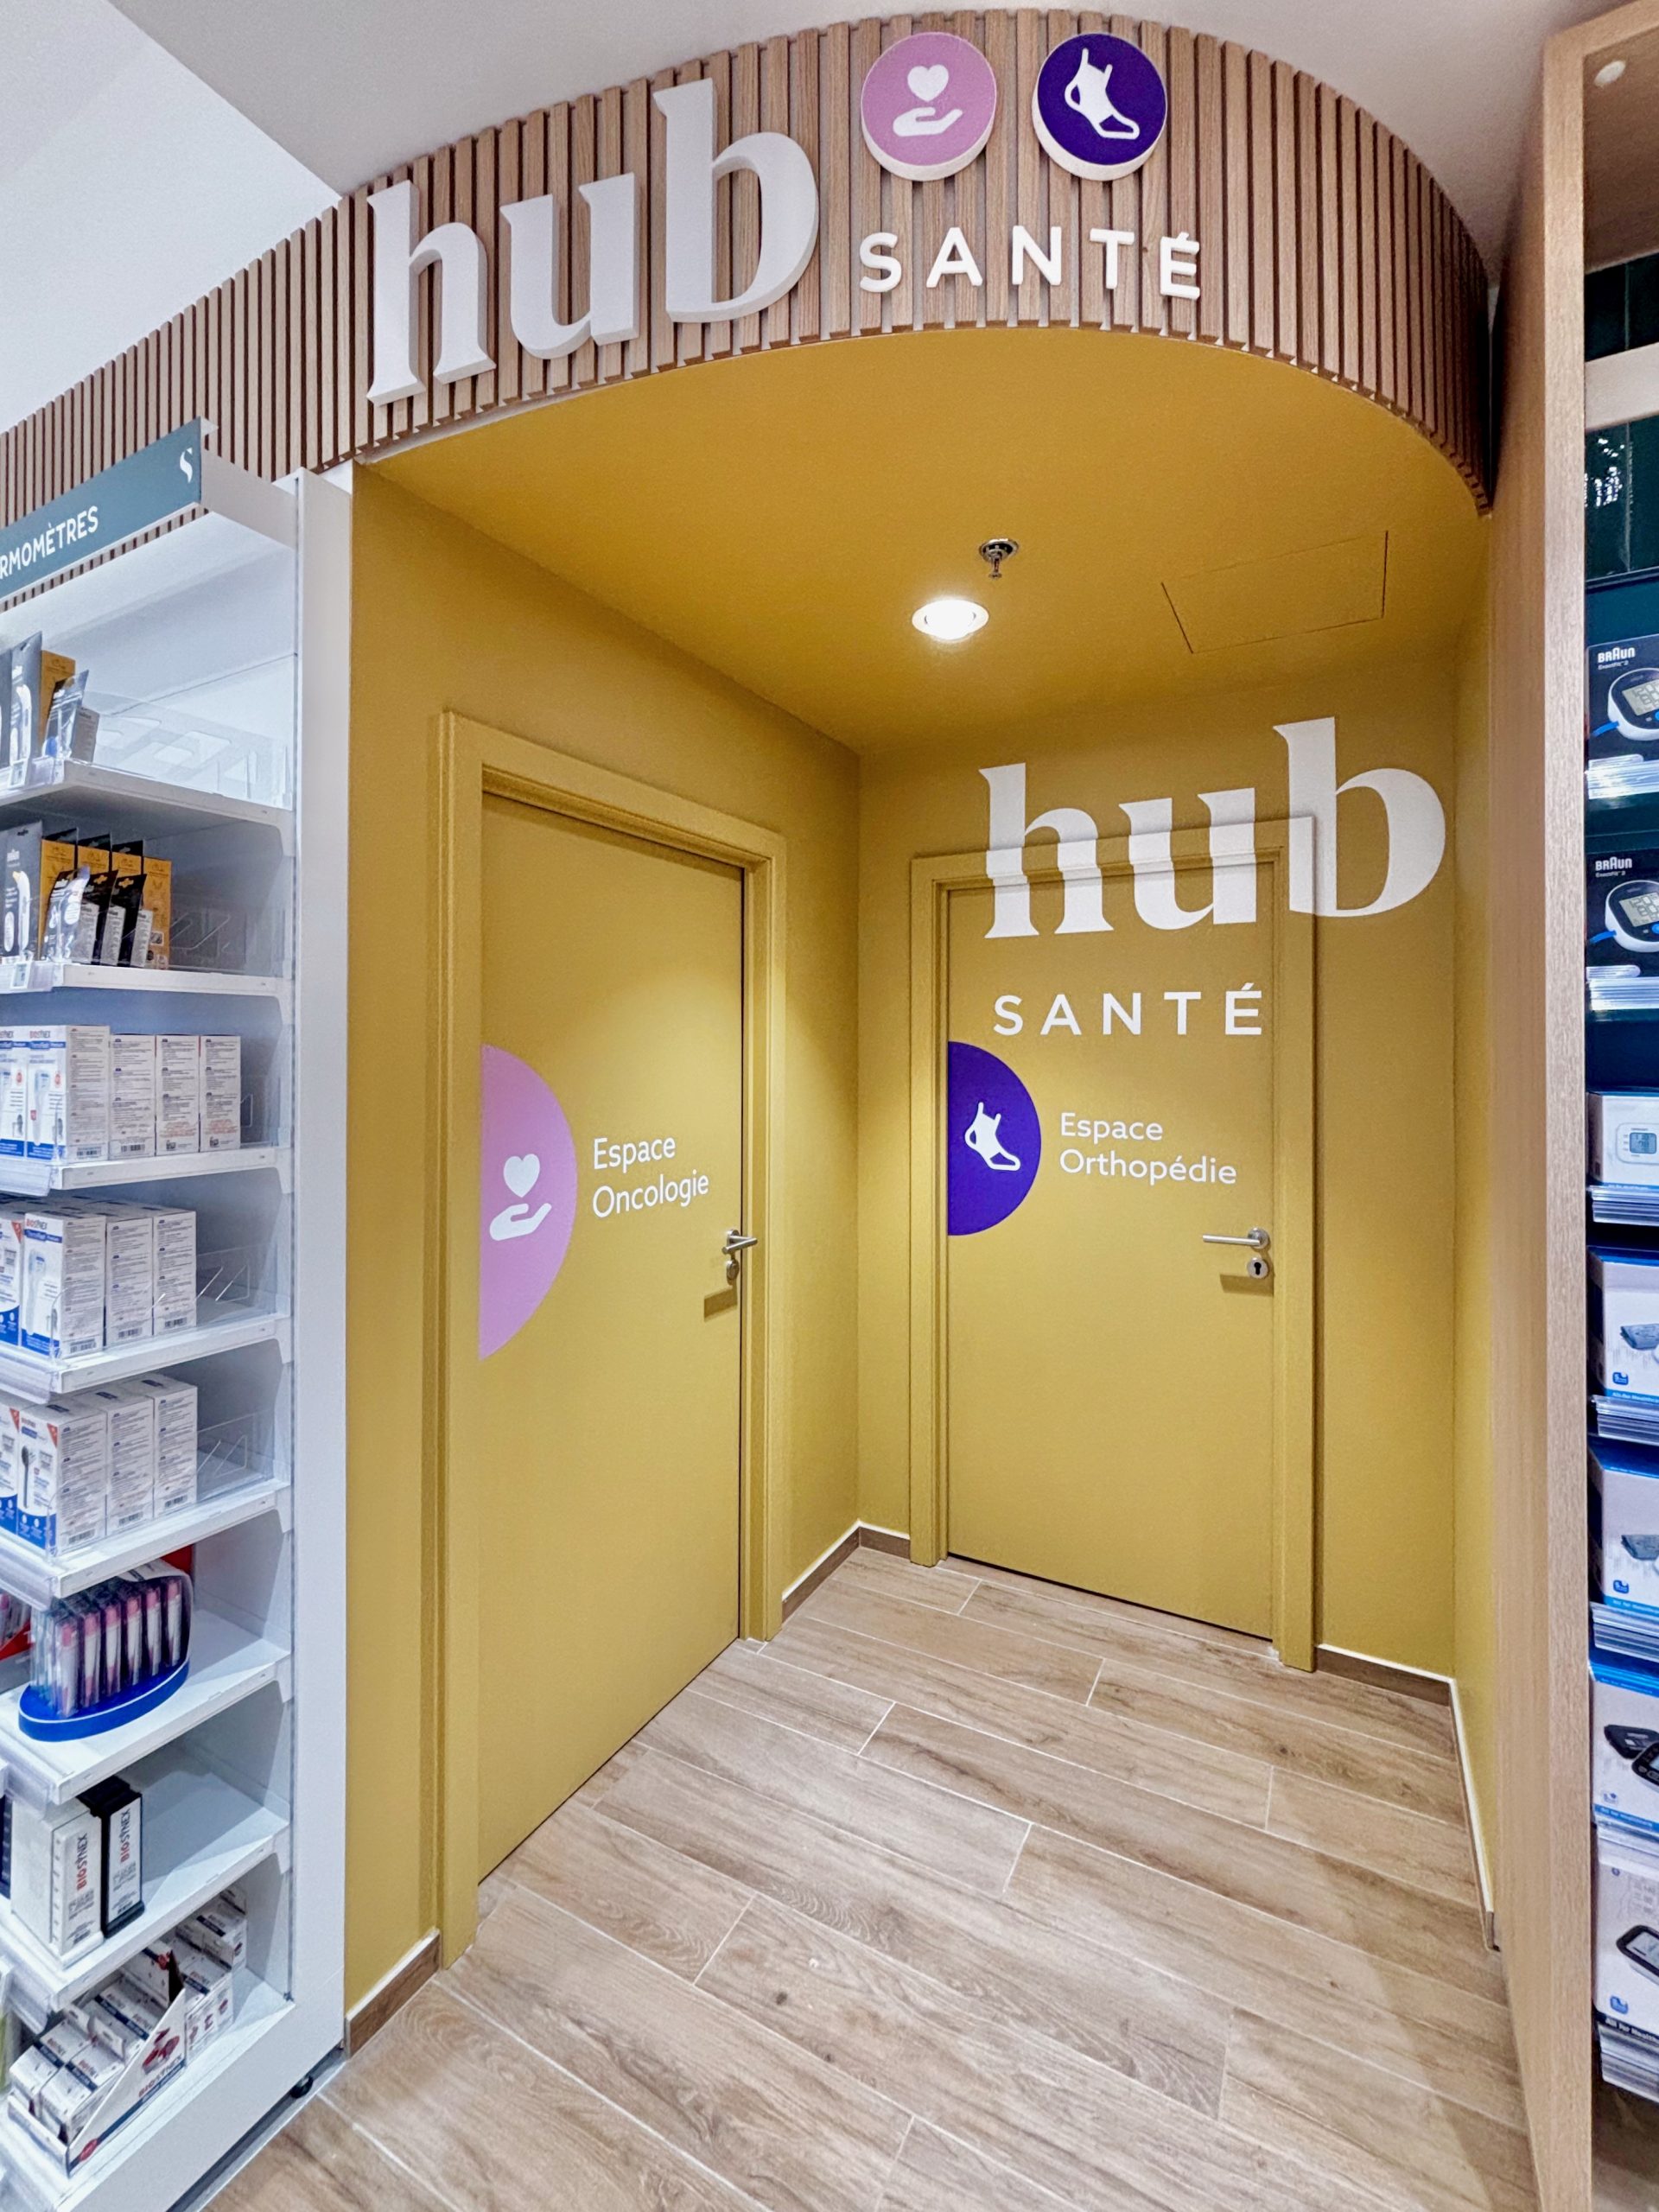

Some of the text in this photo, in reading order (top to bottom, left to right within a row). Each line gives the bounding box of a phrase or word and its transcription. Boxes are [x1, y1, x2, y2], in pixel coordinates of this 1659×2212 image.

[366, 78, 819, 406] hub
[859, 226, 1201, 300] SANTÉ
[1598, 646, 1636, 664] BRAUN
[978, 716, 1446, 938] hub
[1595, 856, 1633, 871] BRAUN
[993, 982, 1262, 1035] SANTÉ
[1060, 1112, 1163, 1145] Espace
[594, 1137, 676, 1173] Espace
[1059, 1148, 1237, 1185] Orthopédie
[593, 1169, 709, 1218] Oncologie
